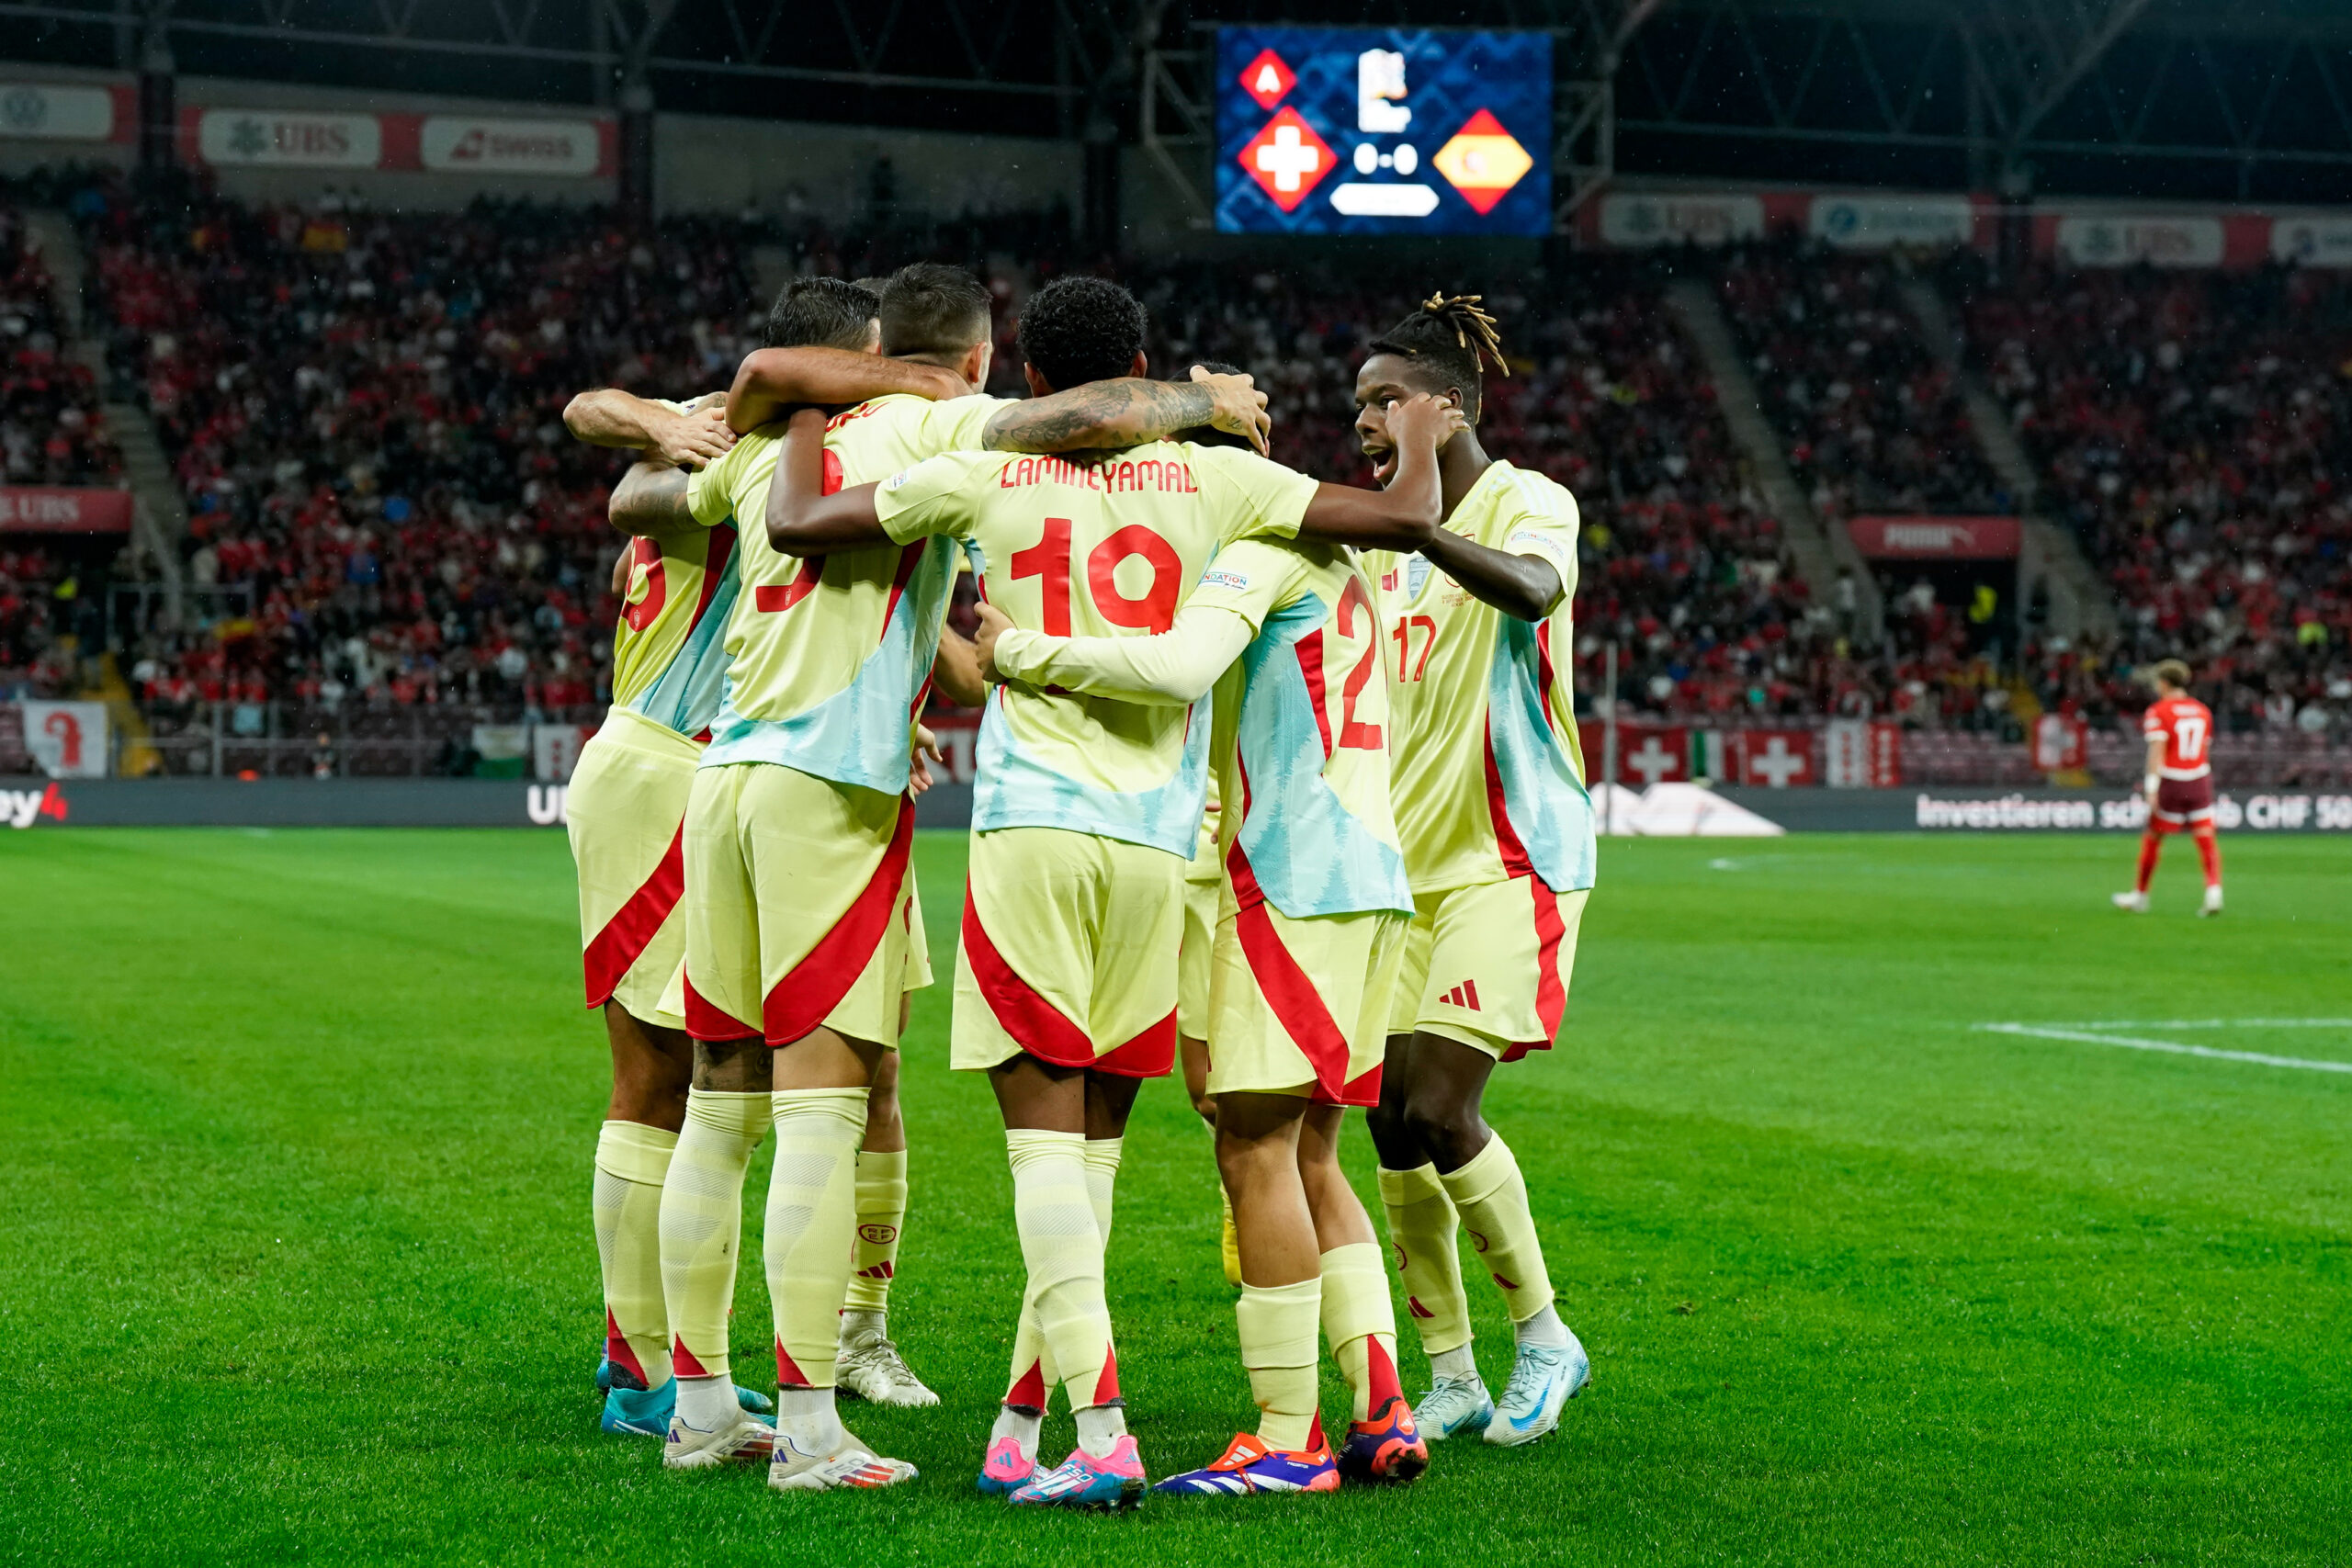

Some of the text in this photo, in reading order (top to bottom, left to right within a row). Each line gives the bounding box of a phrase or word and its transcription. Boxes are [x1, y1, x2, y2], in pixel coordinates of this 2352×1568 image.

[1255, 63, 1281, 93] A
[274, 121, 350, 156] UBS
[1011, 517, 1182, 637] 19
[1393, 615, 1437, 682] 17
[1916, 793, 2095, 829] Investieren
